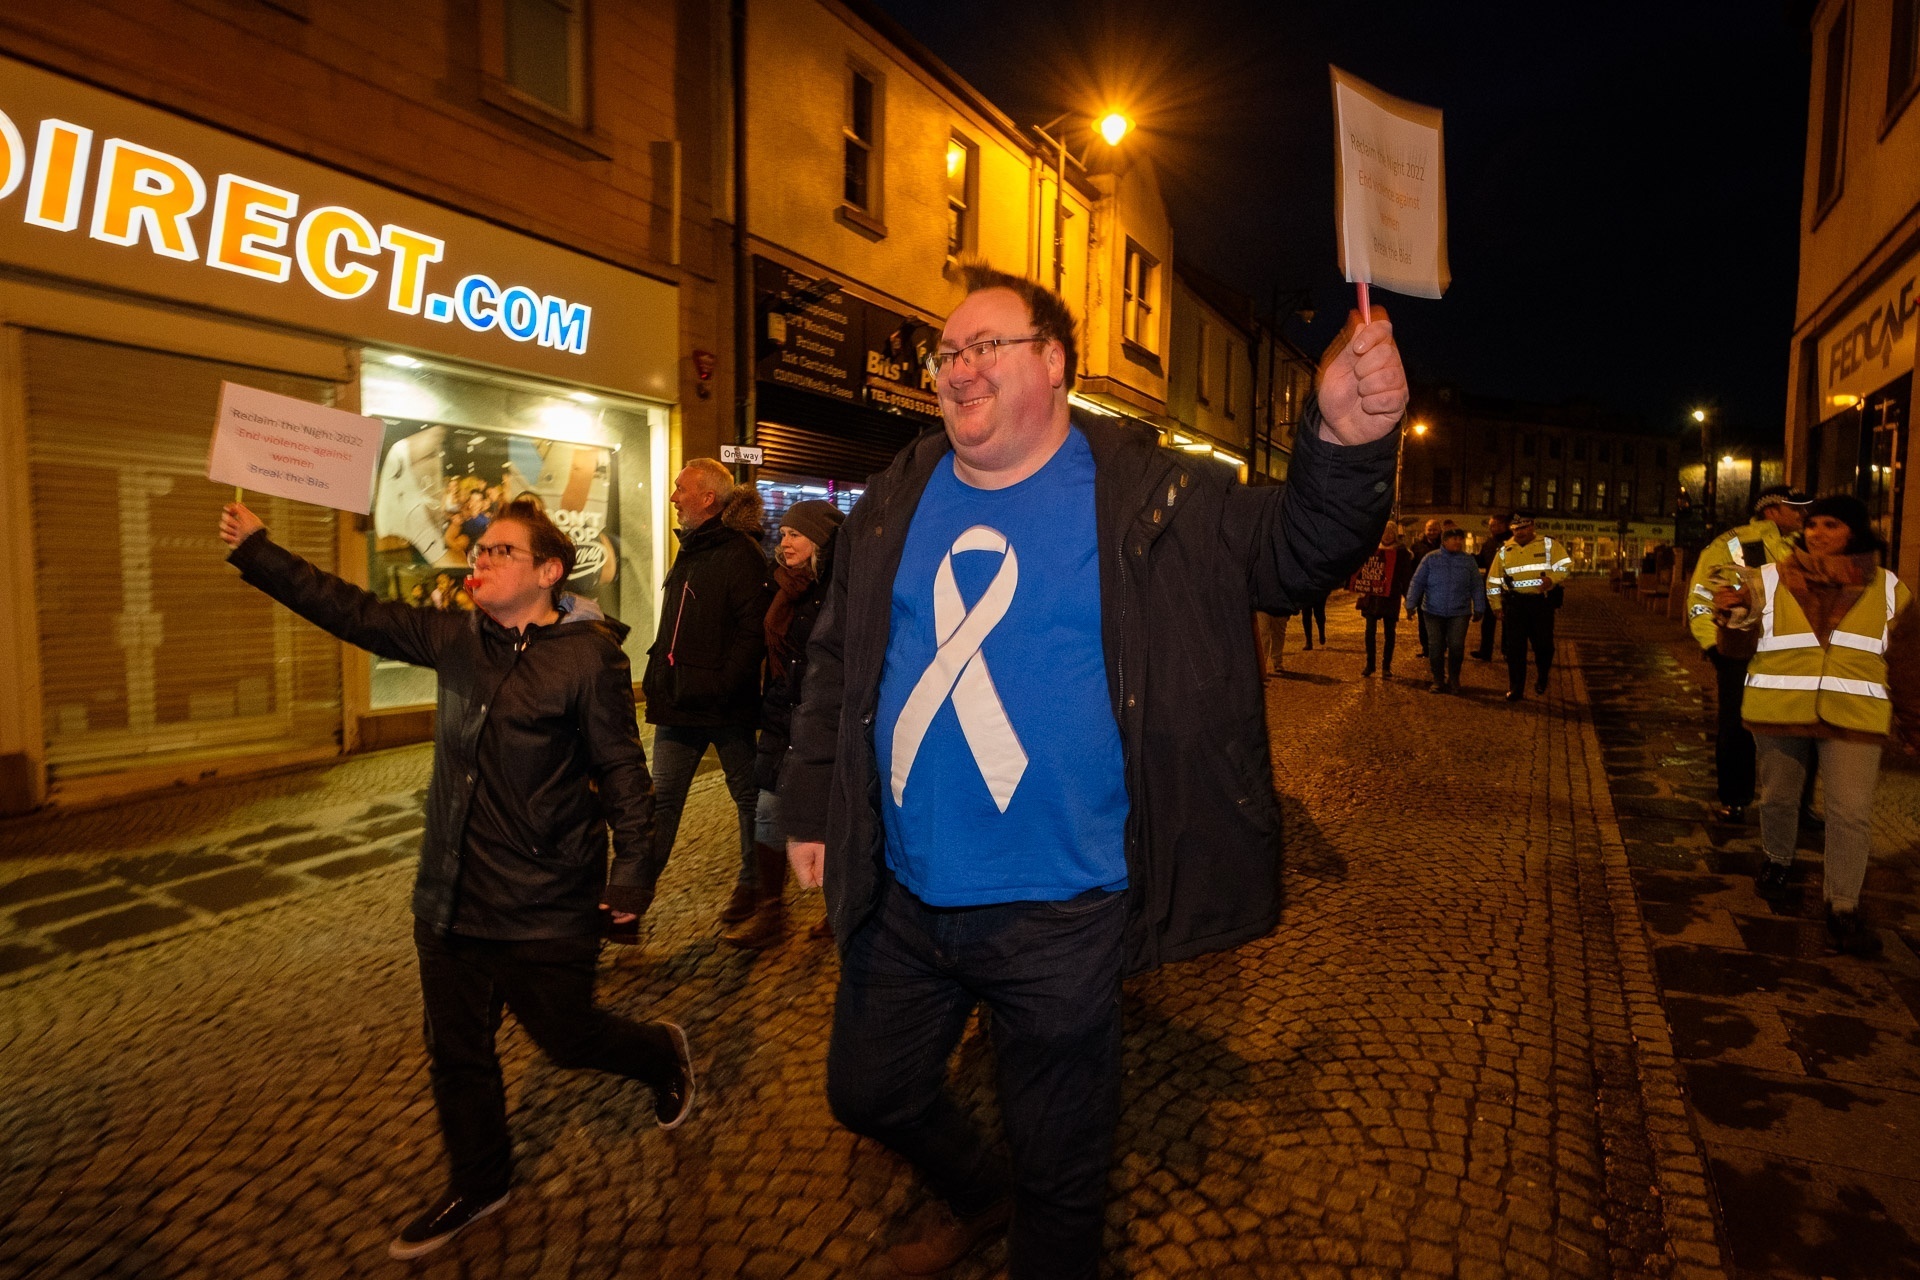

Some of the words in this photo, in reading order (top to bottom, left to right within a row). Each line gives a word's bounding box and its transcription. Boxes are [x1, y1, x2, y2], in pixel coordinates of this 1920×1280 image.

[1350, 133, 1378, 160] Reclaim
[1377, 147, 1387, 167] the
[1386, 154, 1405, 180] Night
[1406, 162, 1425, 181] 2022
[1358, 170, 1373, 190] End
[1372, 177, 1396, 203] violence
[1395, 190, 1420, 210] against
[1380, 212, 1400, 233] women
[1373, 236, 1389, 258] Break
[1388, 244, 1398, 261] the
[1398, 248, 1412, 265] Bias
[795, 335, 836, 357] Printers
[781, 350, 799, 365] Ink
[799, 355, 848, 379] Cartridges
[231, 408, 279, 428] Reclaim
[280, 420, 301, 433] the
[302, 424, 334, 441] Night
[335, 433, 364, 448] 2022
[237, 428, 261, 441] End
[262, 435, 311, 454] violence
[313, 445, 353, 463] against
[743, 453, 759, 461] way
[271, 453, 315, 470] women
[247, 463, 284, 480] Break
[285, 472, 306, 484] the
[306, 476, 330, 490] Bias
[1361, 567, 1384, 576] BLACK
[1363, 561, 1385, 569] LITTLE
